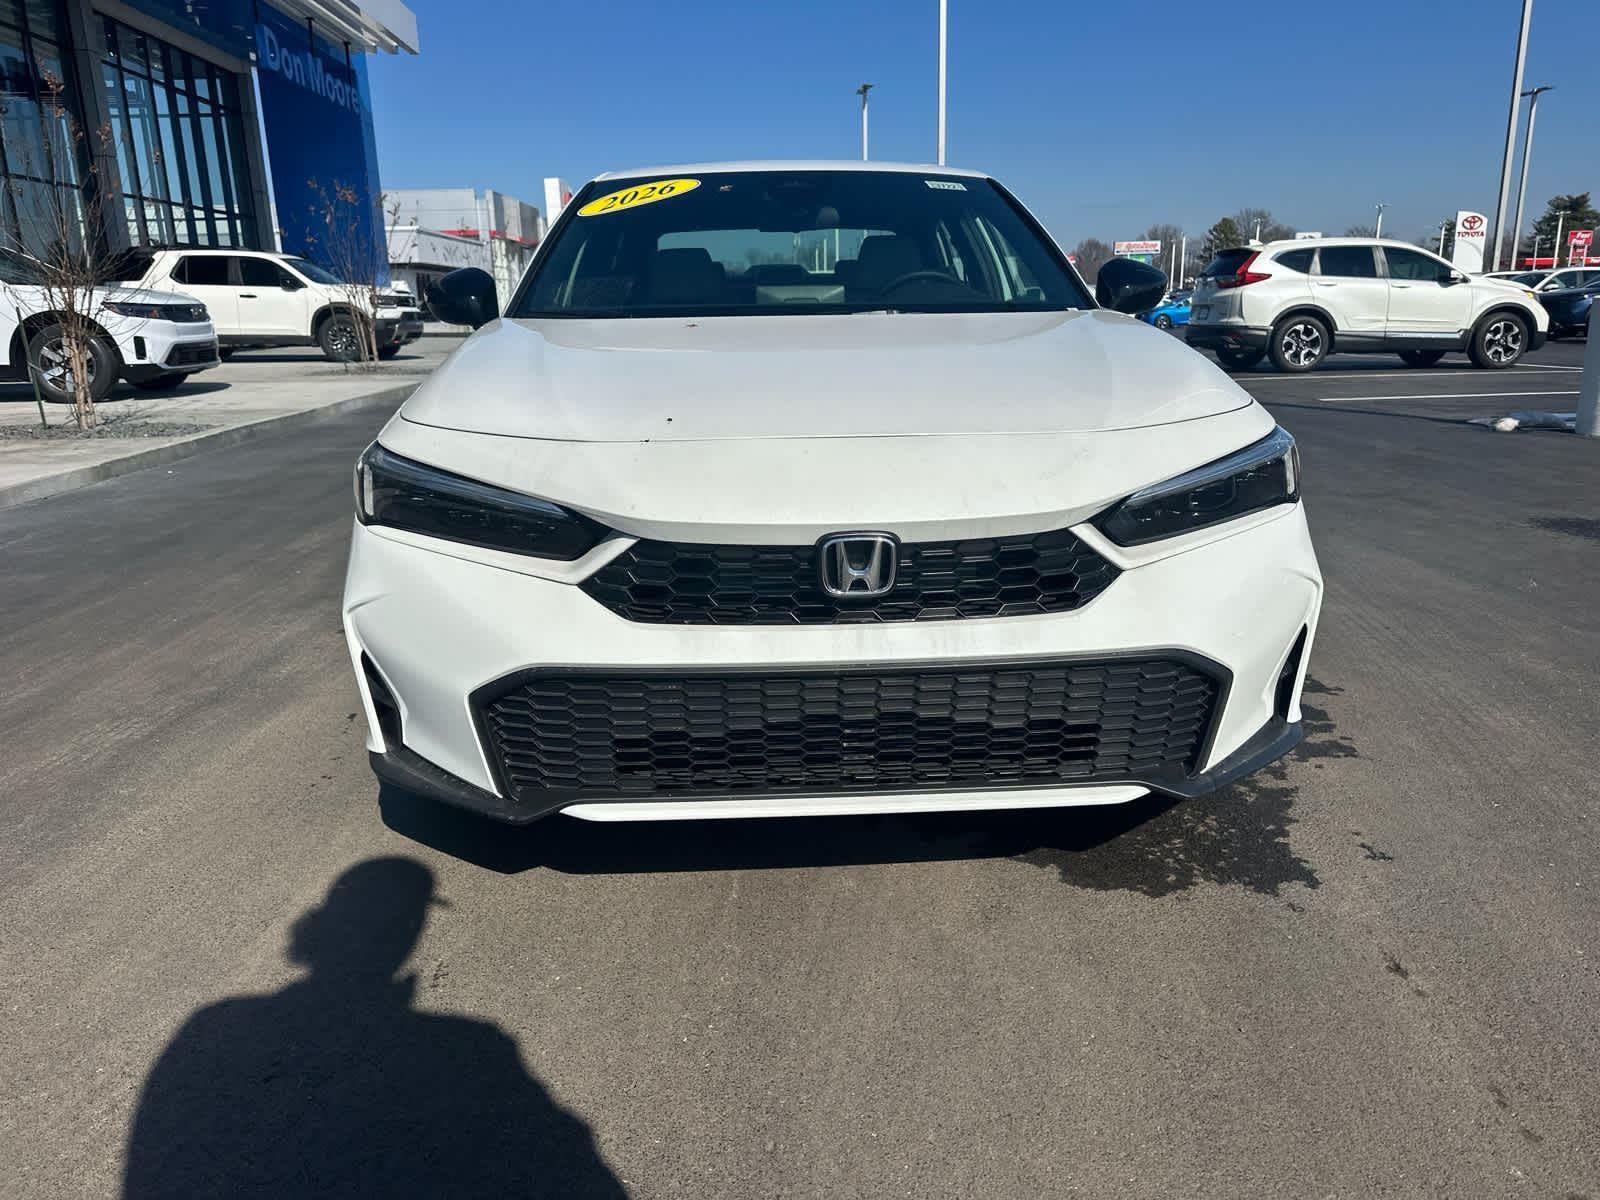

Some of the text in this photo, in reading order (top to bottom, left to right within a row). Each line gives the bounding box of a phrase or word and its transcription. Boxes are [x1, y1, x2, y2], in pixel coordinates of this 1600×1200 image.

[263, 25, 359, 114] Don Moore
[599, 183, 677, 212] 2026
